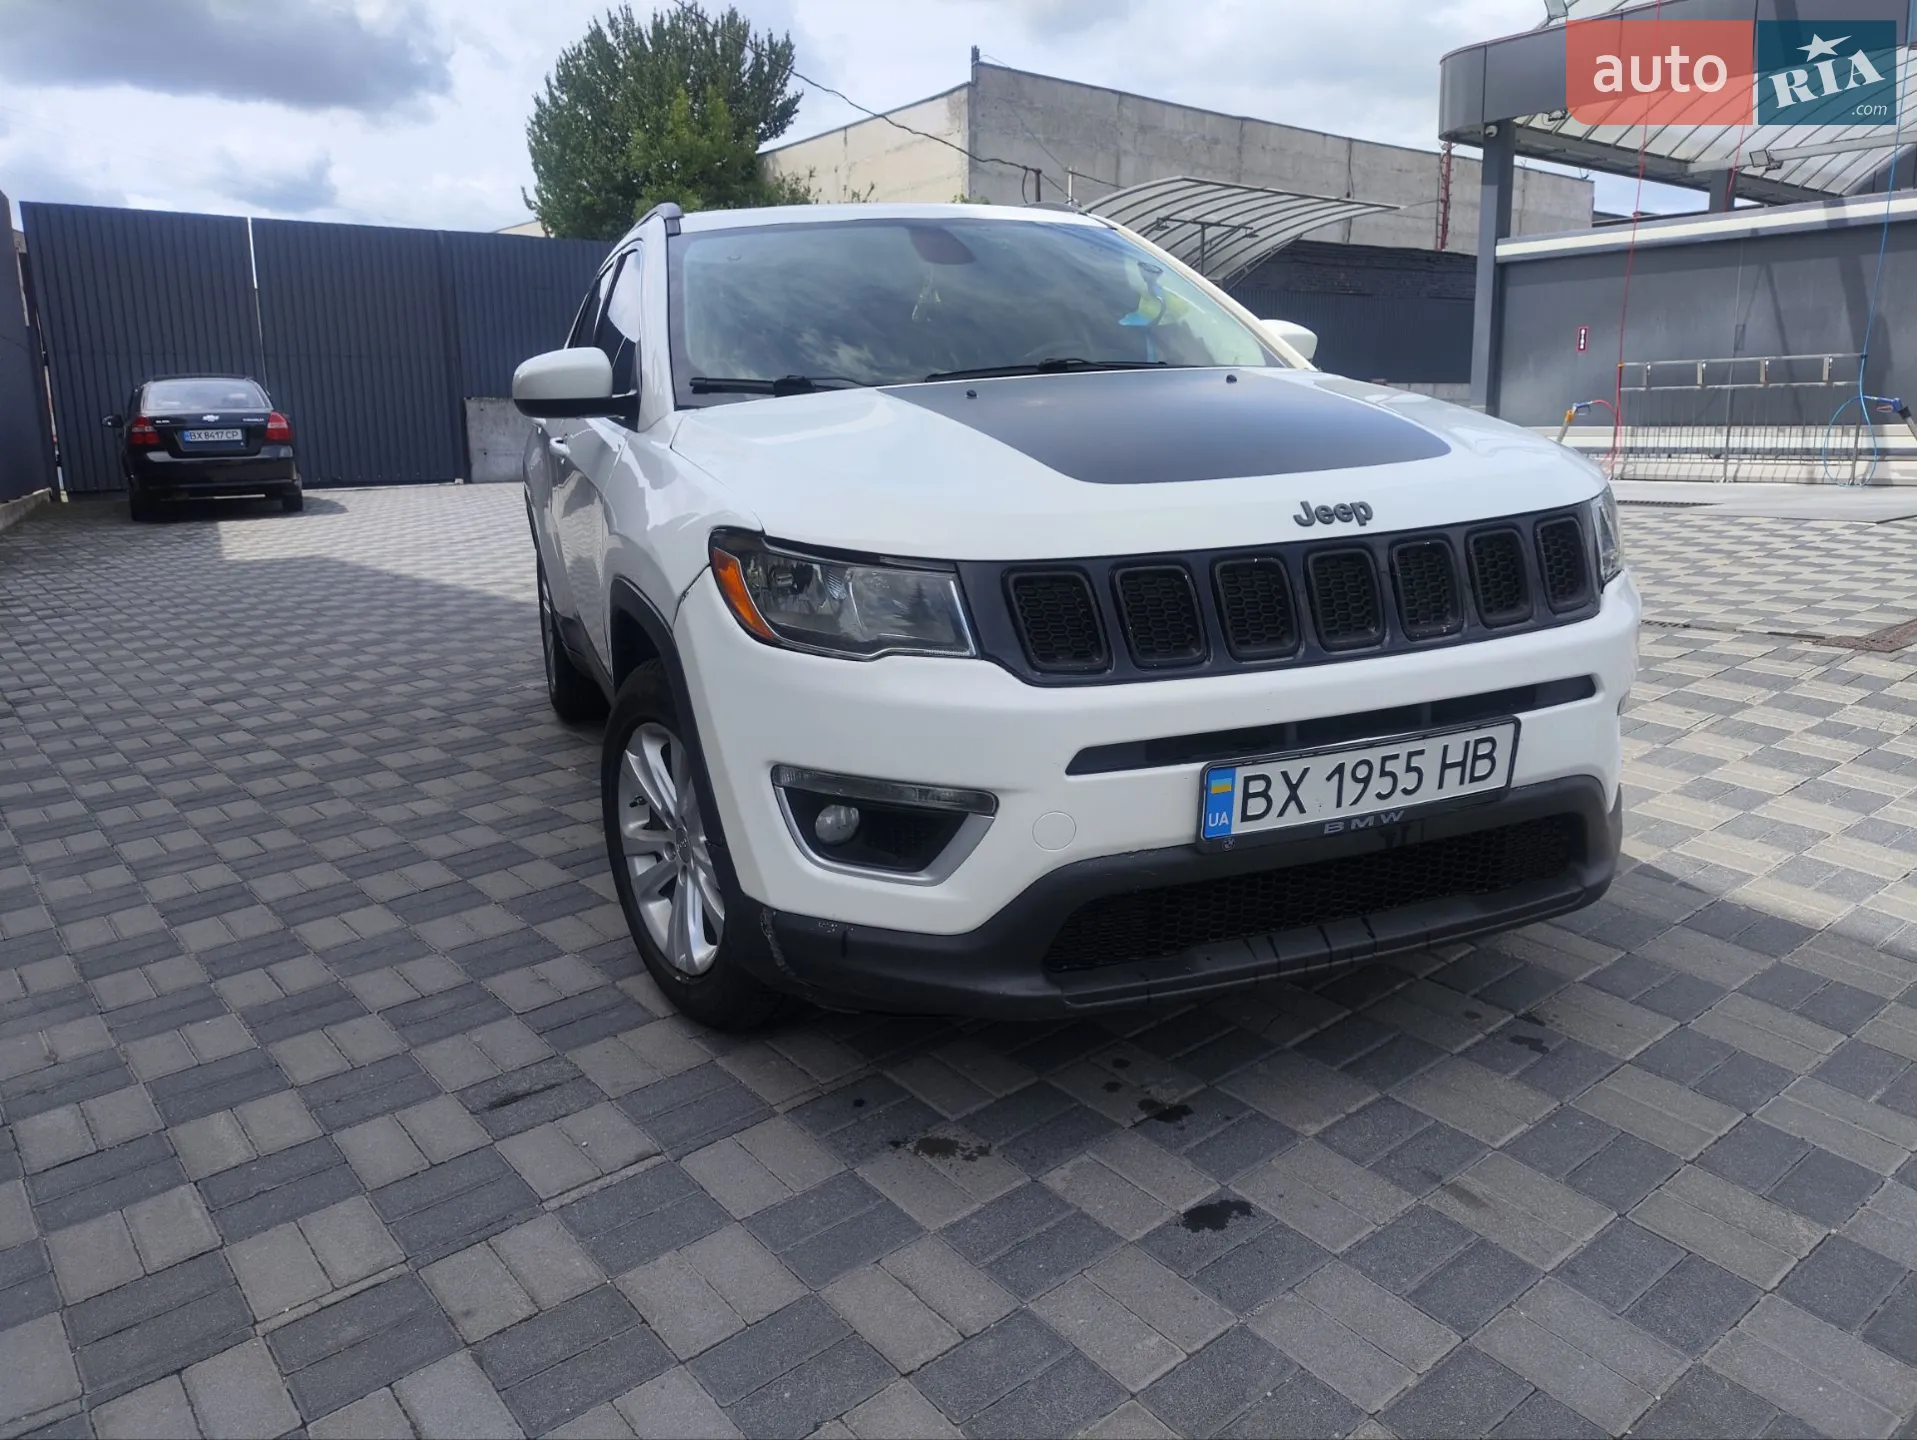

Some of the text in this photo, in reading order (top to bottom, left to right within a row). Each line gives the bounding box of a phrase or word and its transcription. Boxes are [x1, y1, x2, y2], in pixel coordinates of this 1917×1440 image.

[190, 431, 203, 440] BX
[204, 431, 224, 440] 8417
[225, 430, 239, 439] CP
[1293, 500, 1374, 528] Jeep
[1242, 736, 1498, 823] BX 1955 HB
[1208, 812, 1230, 828] UA
[1323, 810, 1405, 835] BMW
